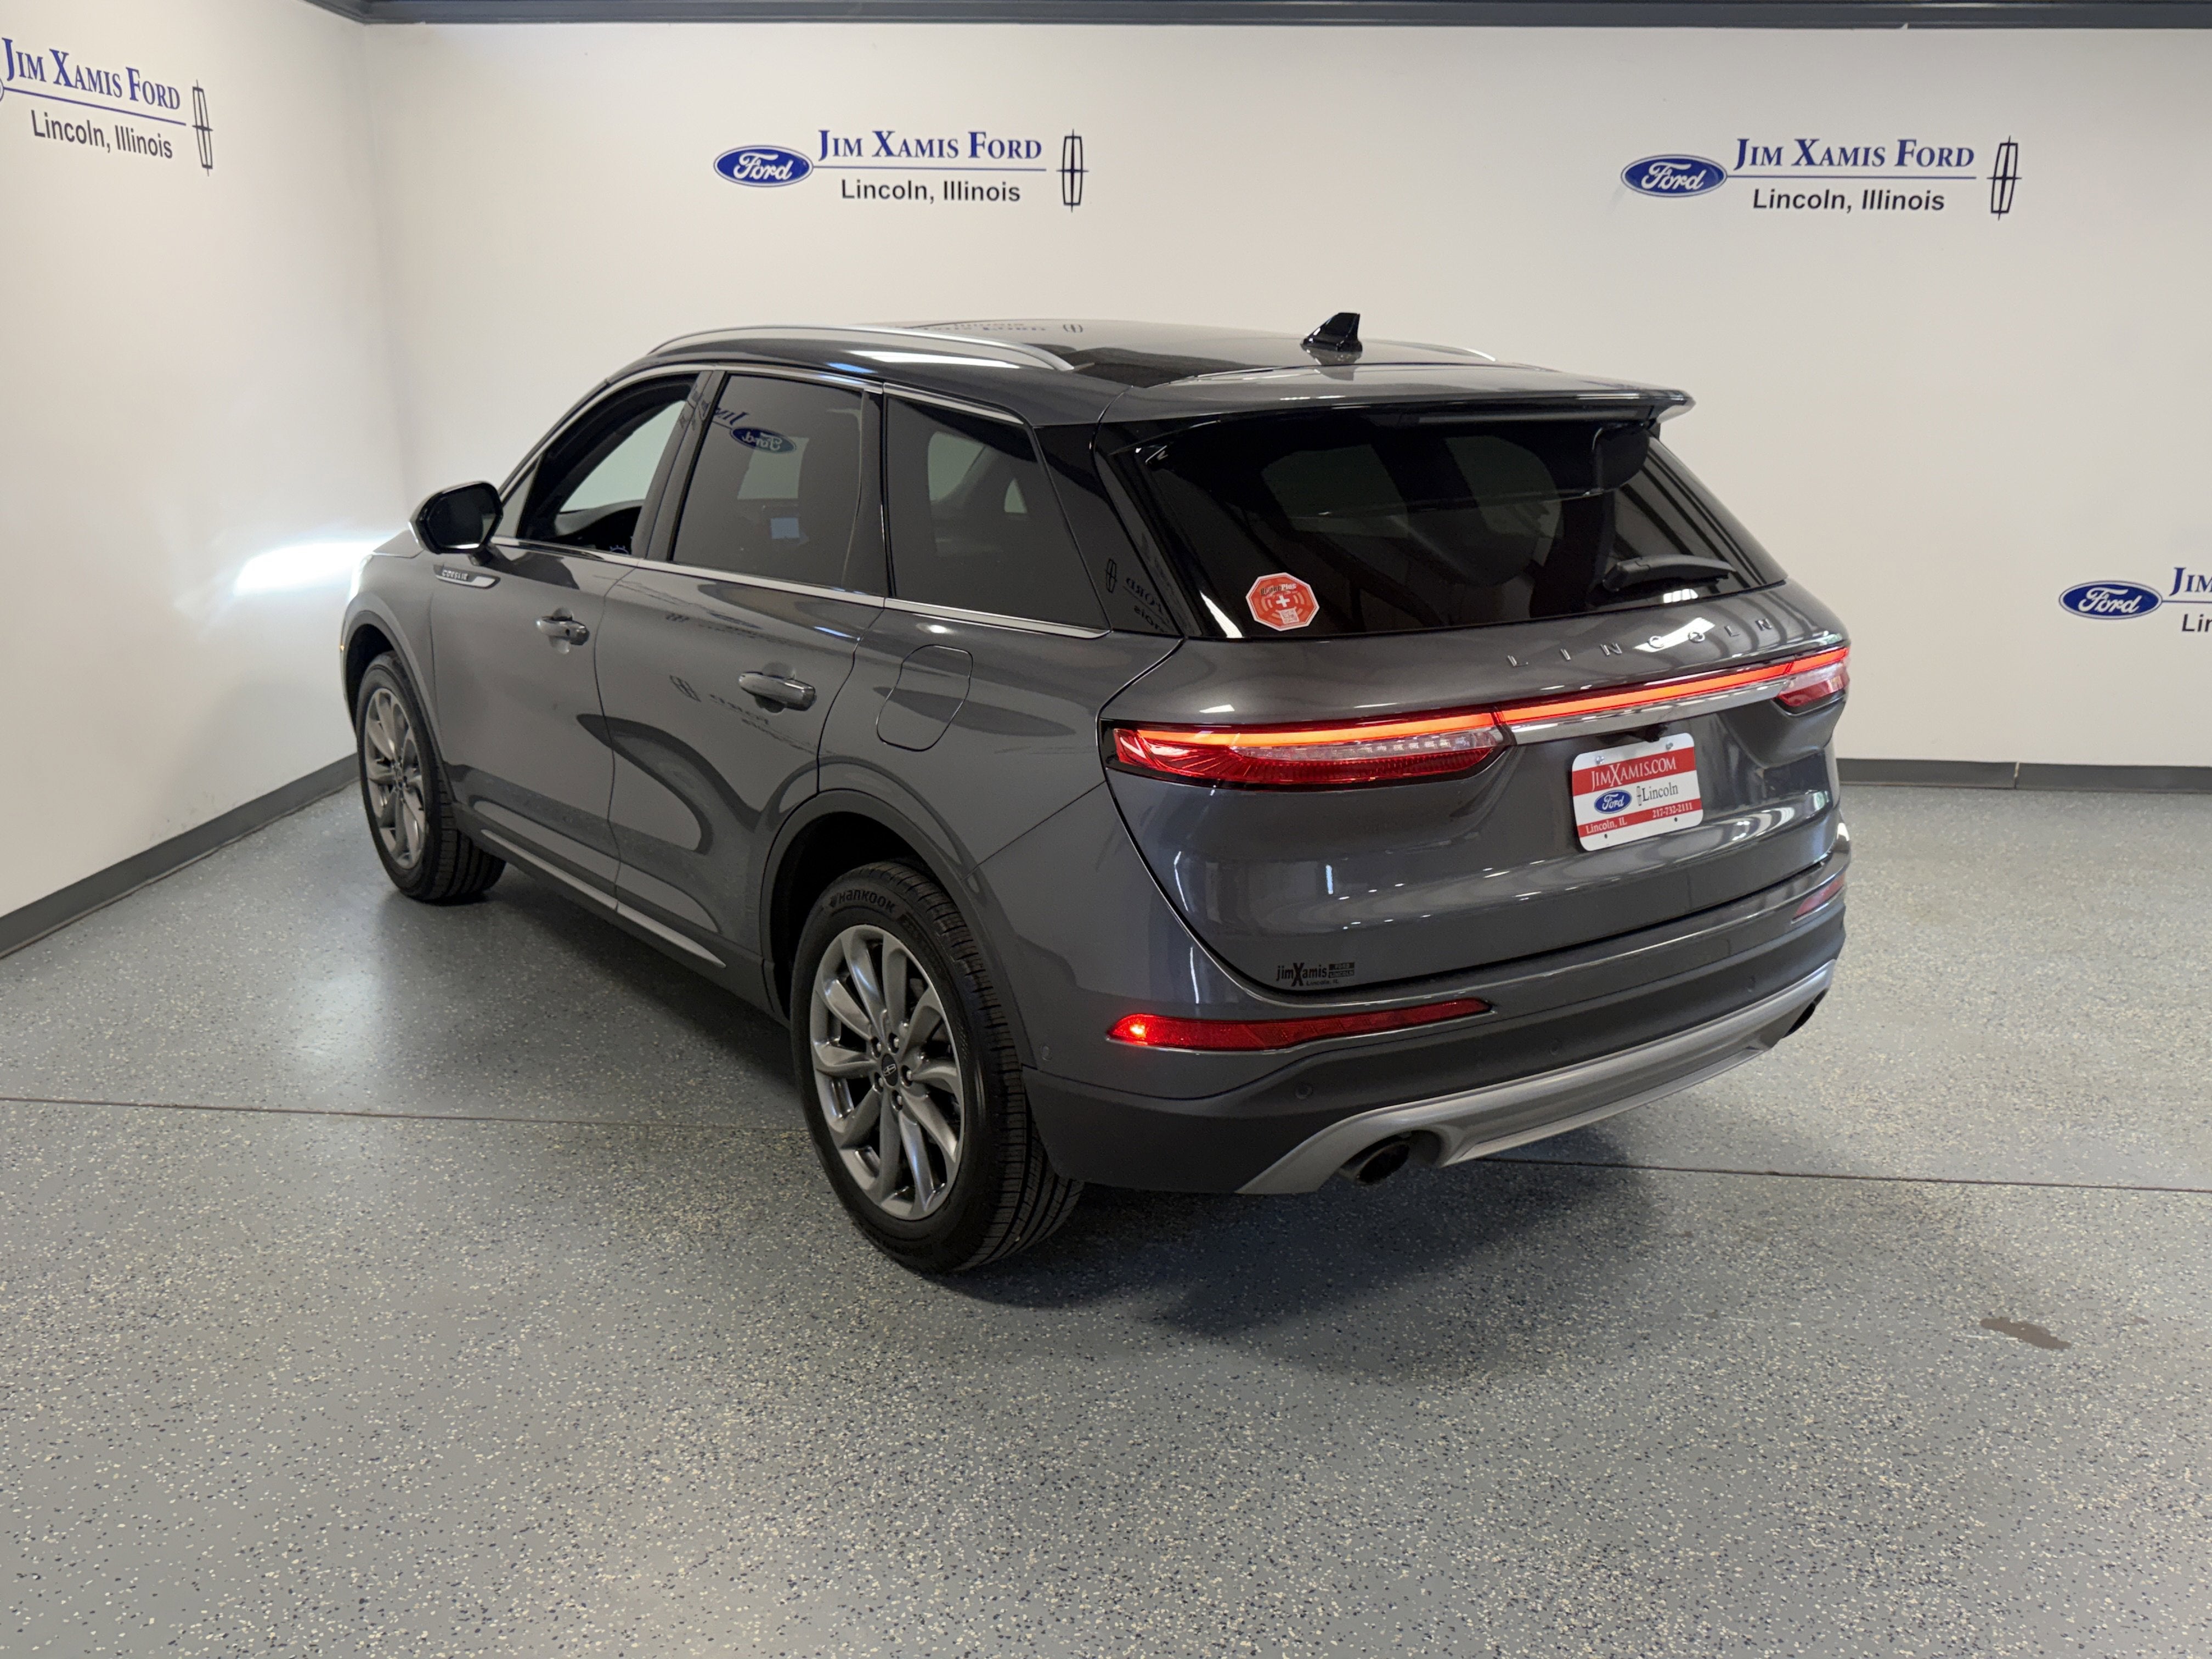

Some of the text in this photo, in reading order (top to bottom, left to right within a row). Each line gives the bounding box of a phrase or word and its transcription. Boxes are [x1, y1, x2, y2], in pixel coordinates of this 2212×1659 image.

[2, 37, 180, 110] JIM XAMIS FORD
[31, 110, 173, 159] Lincoln, Illinois
[818, 129, 1042, 162] JIM XAMIS FORD
[733, 153, 792, 181] Ford
[1733, 138, 1975, 171] JIM XAMIS FORD
[842, 179, 1020, 204] Lincoln, Illinois
[1641, 162, 1706, 191] Ford
[1753, 188, 1945, 213] Lincoln, Illinois
[2169, 567, 2212, 597] JIM
[2078, 586, 2142, 614] Ford
[1507, 618, 1773, 668] LINCOLN
[1590, 756, 1677, 791] JIMXAMIS.COM
[1602, 781, 1679, 810] Ford Lincoln
[1585, 802, 1694, 834] Lincoln, IL 217-732-2111
